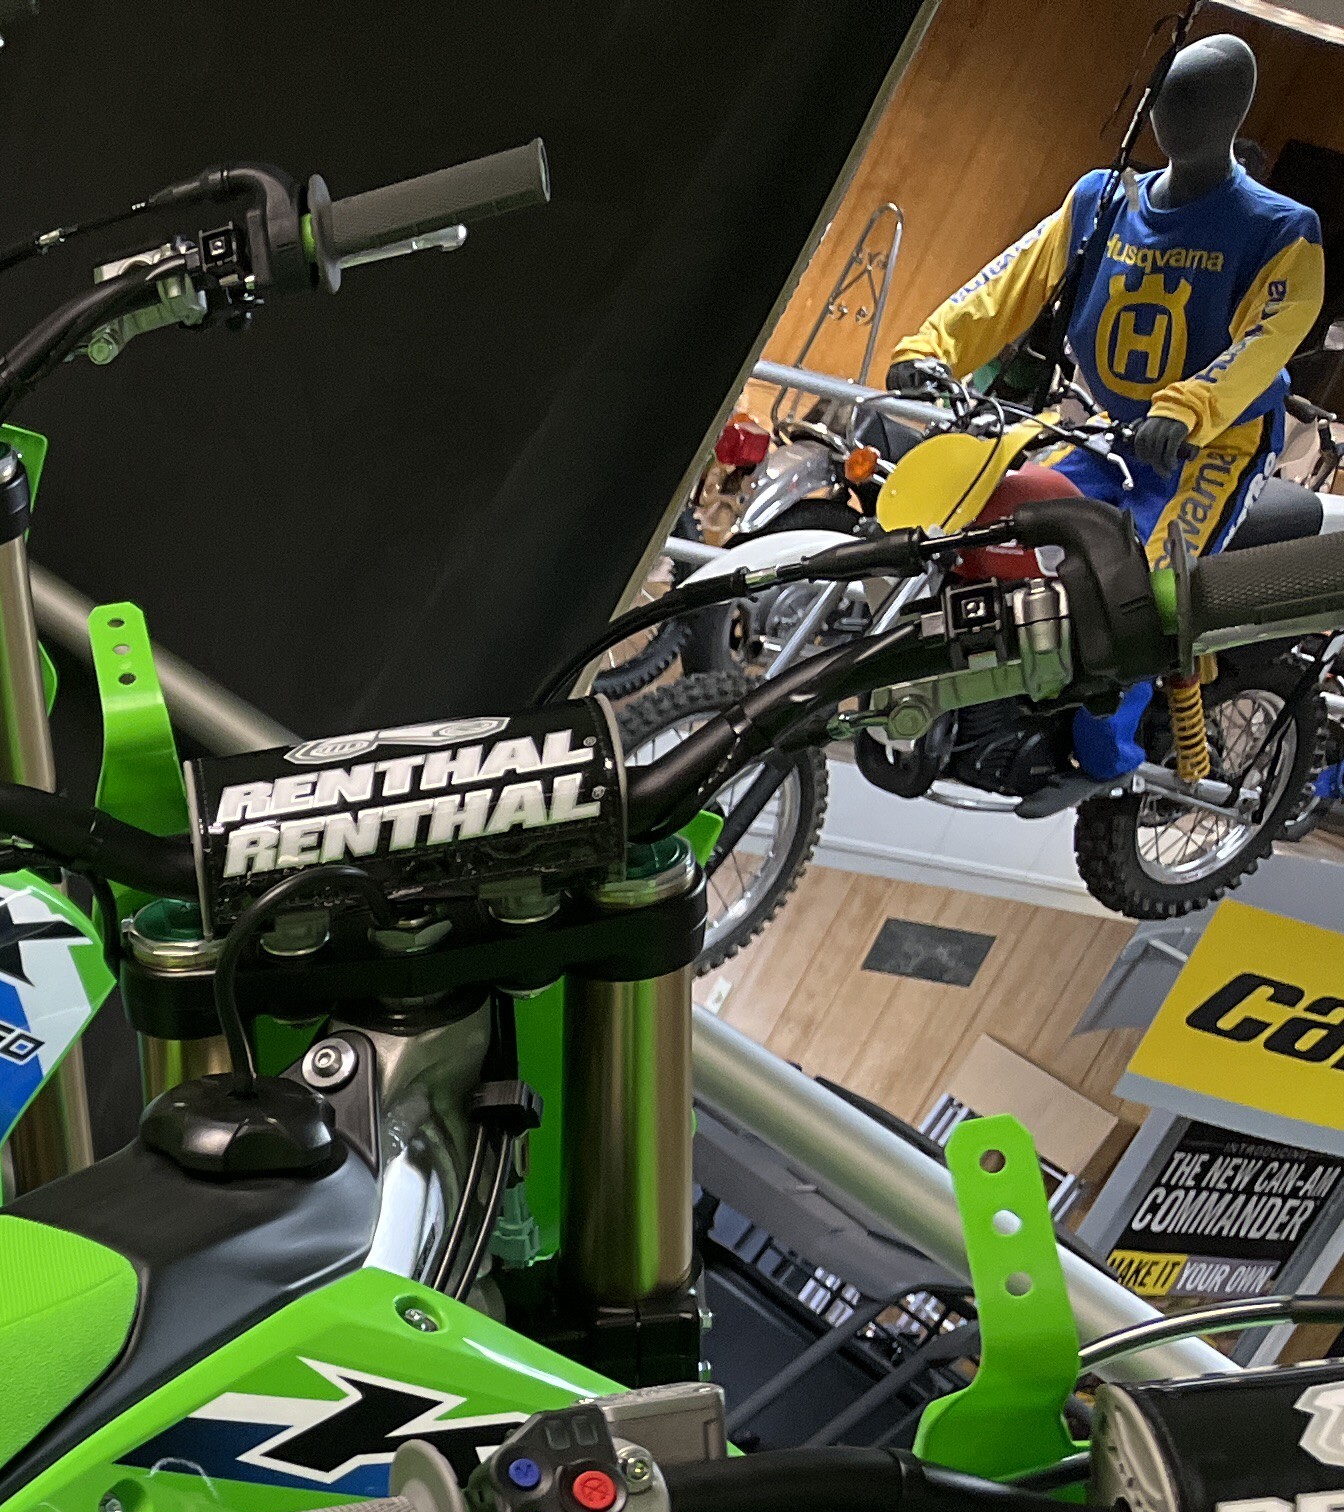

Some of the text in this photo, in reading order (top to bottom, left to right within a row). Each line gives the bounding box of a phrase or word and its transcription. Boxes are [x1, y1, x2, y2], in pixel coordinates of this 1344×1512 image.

[215, 729, 594, 823] RENTHAL
[223, 773, 601, 878] RENTHAL
[1160, 1151, 1342, 1198] THE NEW CAN-AM
[1131, 1186, 1315, 1241] COMMANDER
[1153, 1259, 1181, 1289] IT
[1176, 1261, 1231, 1292] YOUR
[1224, 1264, 1275, 1294] OWN
